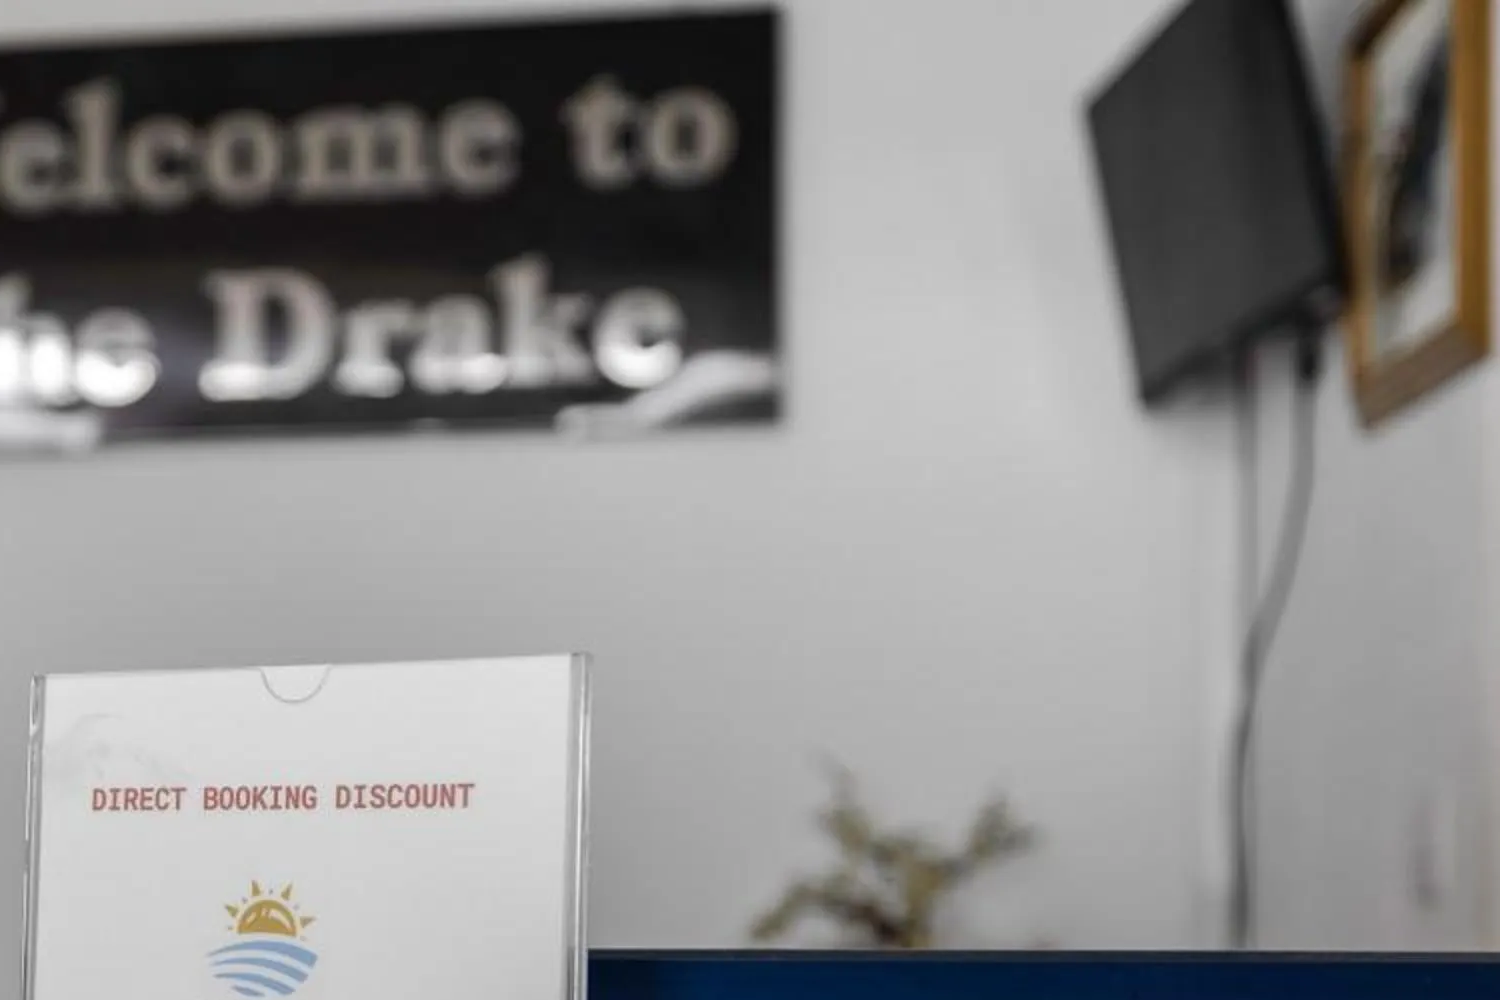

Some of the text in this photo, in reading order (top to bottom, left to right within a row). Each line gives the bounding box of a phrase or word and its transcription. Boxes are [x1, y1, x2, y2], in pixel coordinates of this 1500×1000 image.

[564, 76, 736, 184] to
[200, 256, 688, 400] Drake
[91, 782, 476, 813] DIRECT BOOKING DISCOUNT
